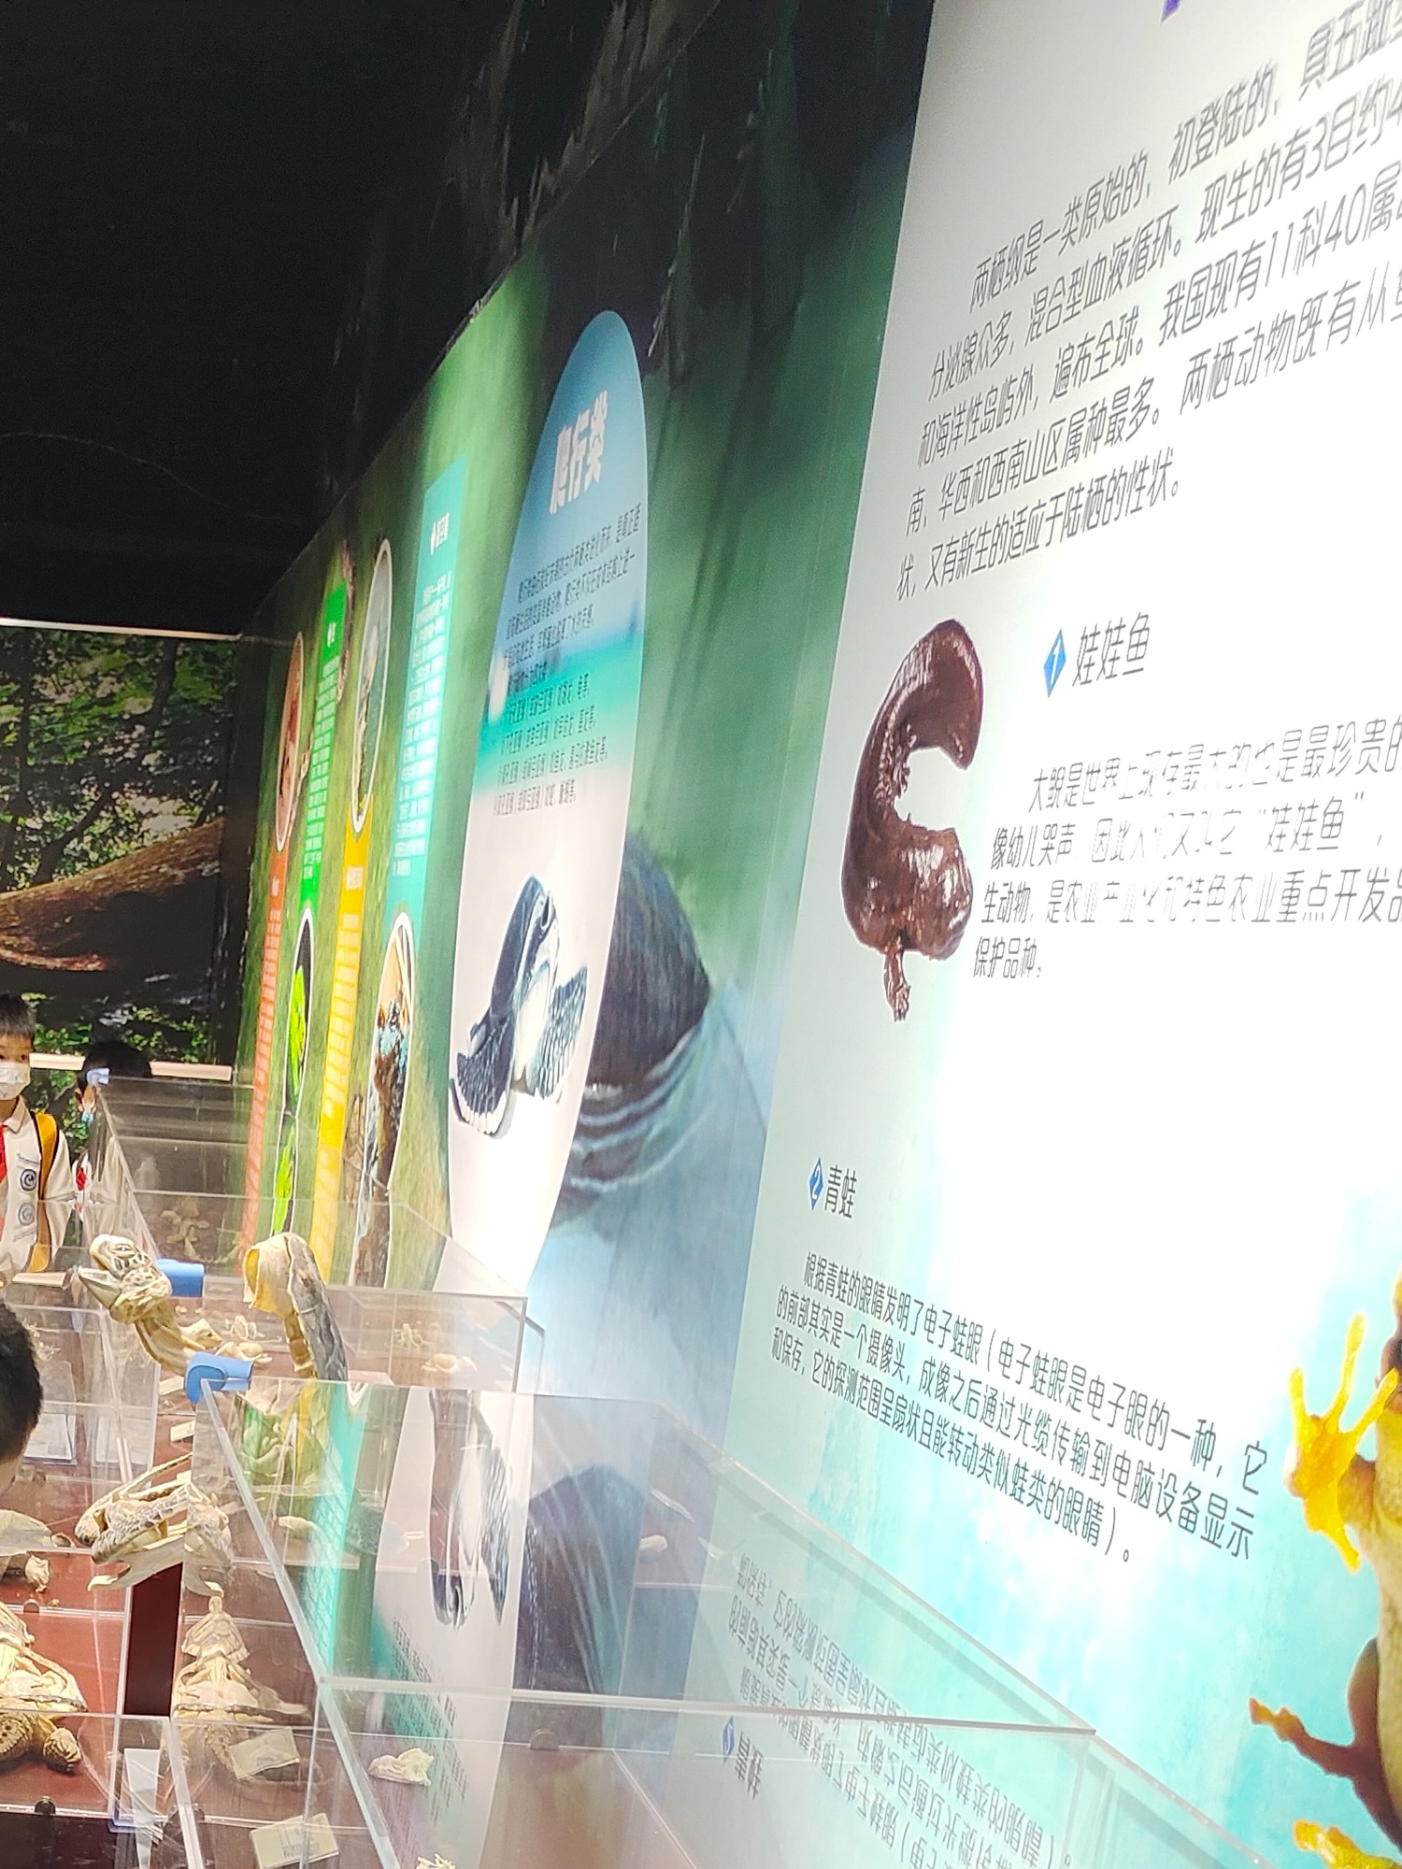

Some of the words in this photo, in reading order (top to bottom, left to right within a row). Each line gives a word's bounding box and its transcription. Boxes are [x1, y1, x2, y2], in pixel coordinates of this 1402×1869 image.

[969, 0, 1402, 314] 两栖纲是一类原始的、初登陆的、具五趾
[918, 160, 1402, 469] 和海洋性岛屿外，遍布全球。我国现有11科40属
[1072, 611, 1150, 688] 娃娃鱼
[824, 1164, 858, 1220] 青蛙
